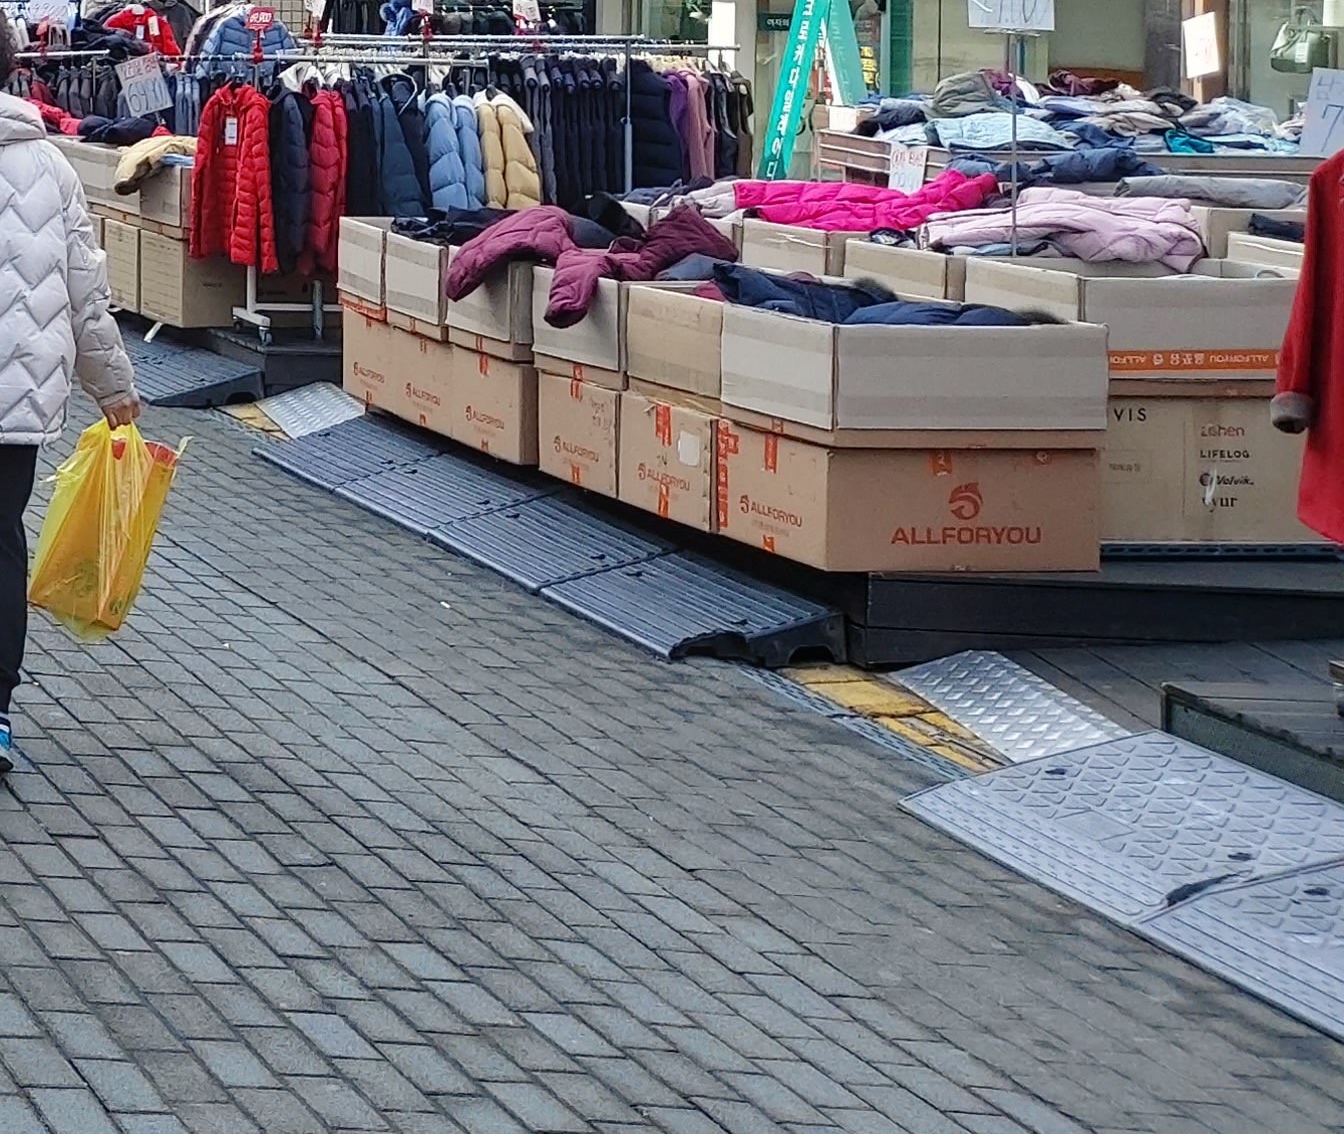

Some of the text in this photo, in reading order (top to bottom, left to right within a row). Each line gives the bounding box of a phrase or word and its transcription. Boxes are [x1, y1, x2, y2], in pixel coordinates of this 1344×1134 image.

[1200, 449, 1250, 459] LIFELOG
[751, 501, 804, 528] ALLFORYOU
[890, 526, 1042, 546] ALLFORYOU
